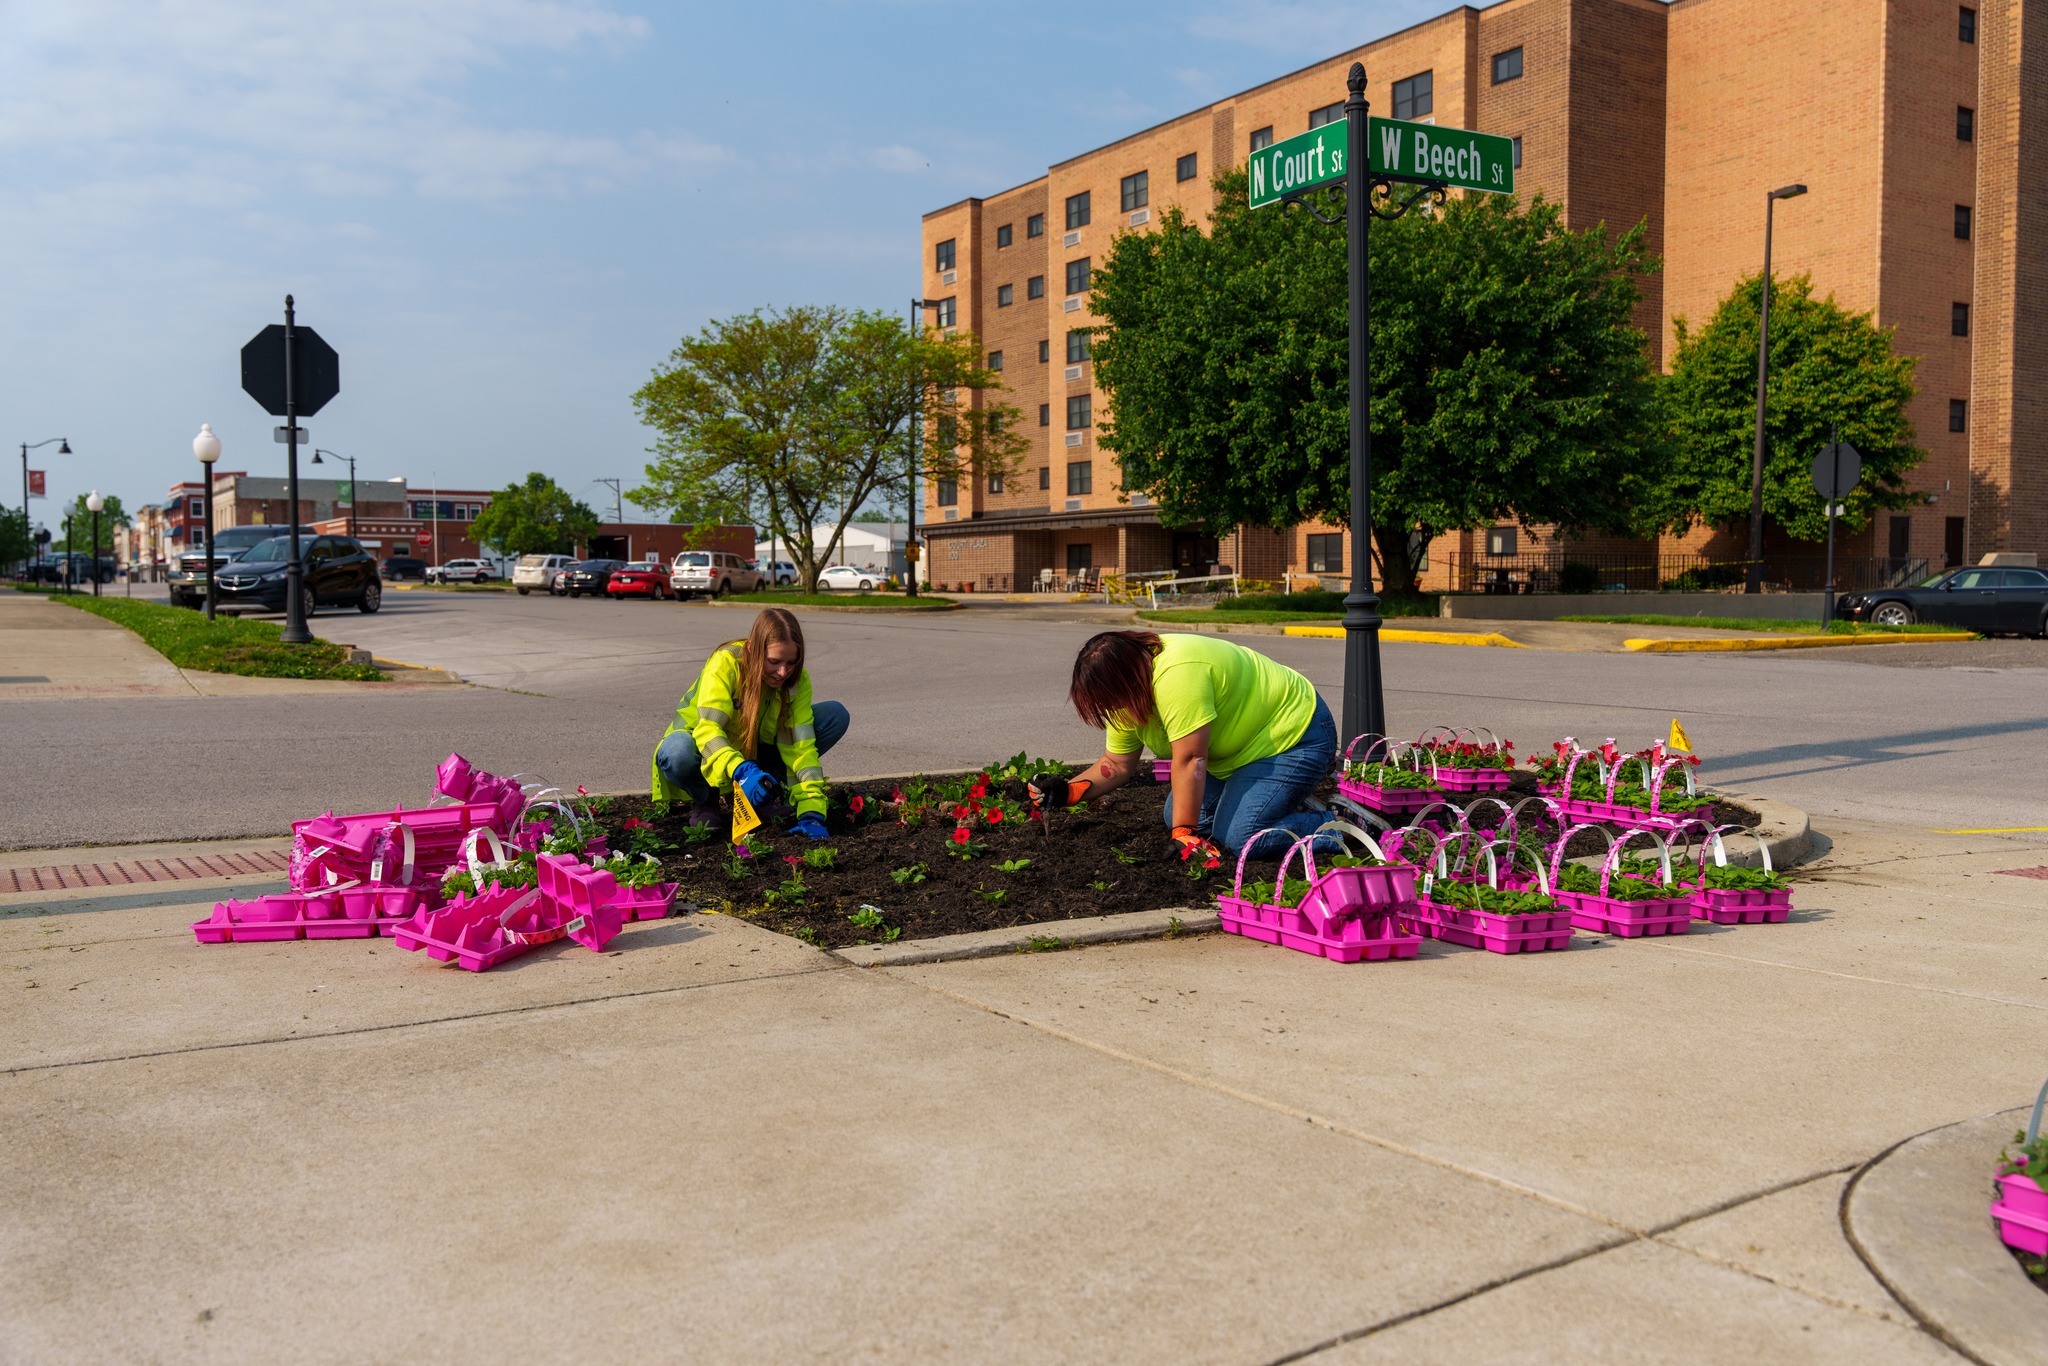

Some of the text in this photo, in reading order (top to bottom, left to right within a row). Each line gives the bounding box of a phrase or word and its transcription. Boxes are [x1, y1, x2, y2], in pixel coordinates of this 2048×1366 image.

[1253, 134, 1343, 199] N Court St
[1381, 126, 1504, 185] W Beech St
[416, 534, 432, 542] STOP
[734, 791, 752, 821] WARNING
